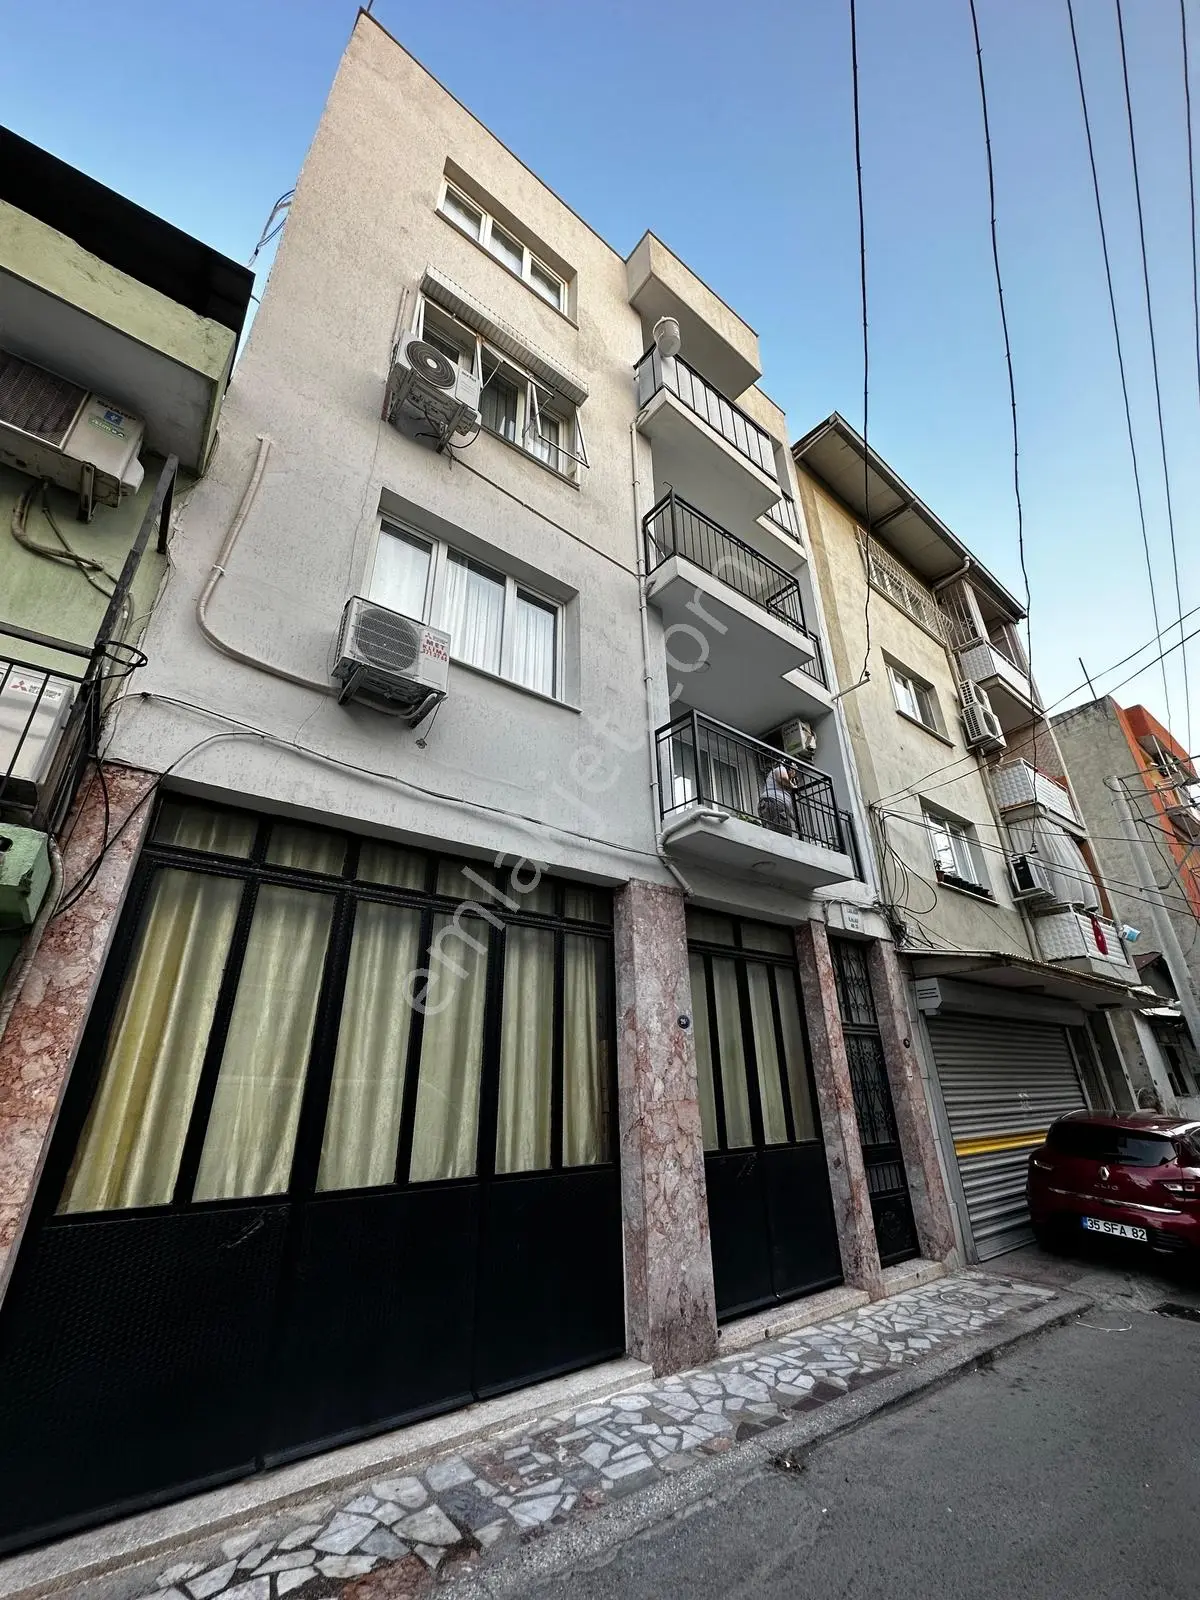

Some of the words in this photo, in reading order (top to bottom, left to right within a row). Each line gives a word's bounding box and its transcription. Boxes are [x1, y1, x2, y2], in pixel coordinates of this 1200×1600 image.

[1087, 1219, 1100, 1230] 35
[1103, 1222, 1127, 1236] SFA
[1131, 1228, 1147, 1240] 82
